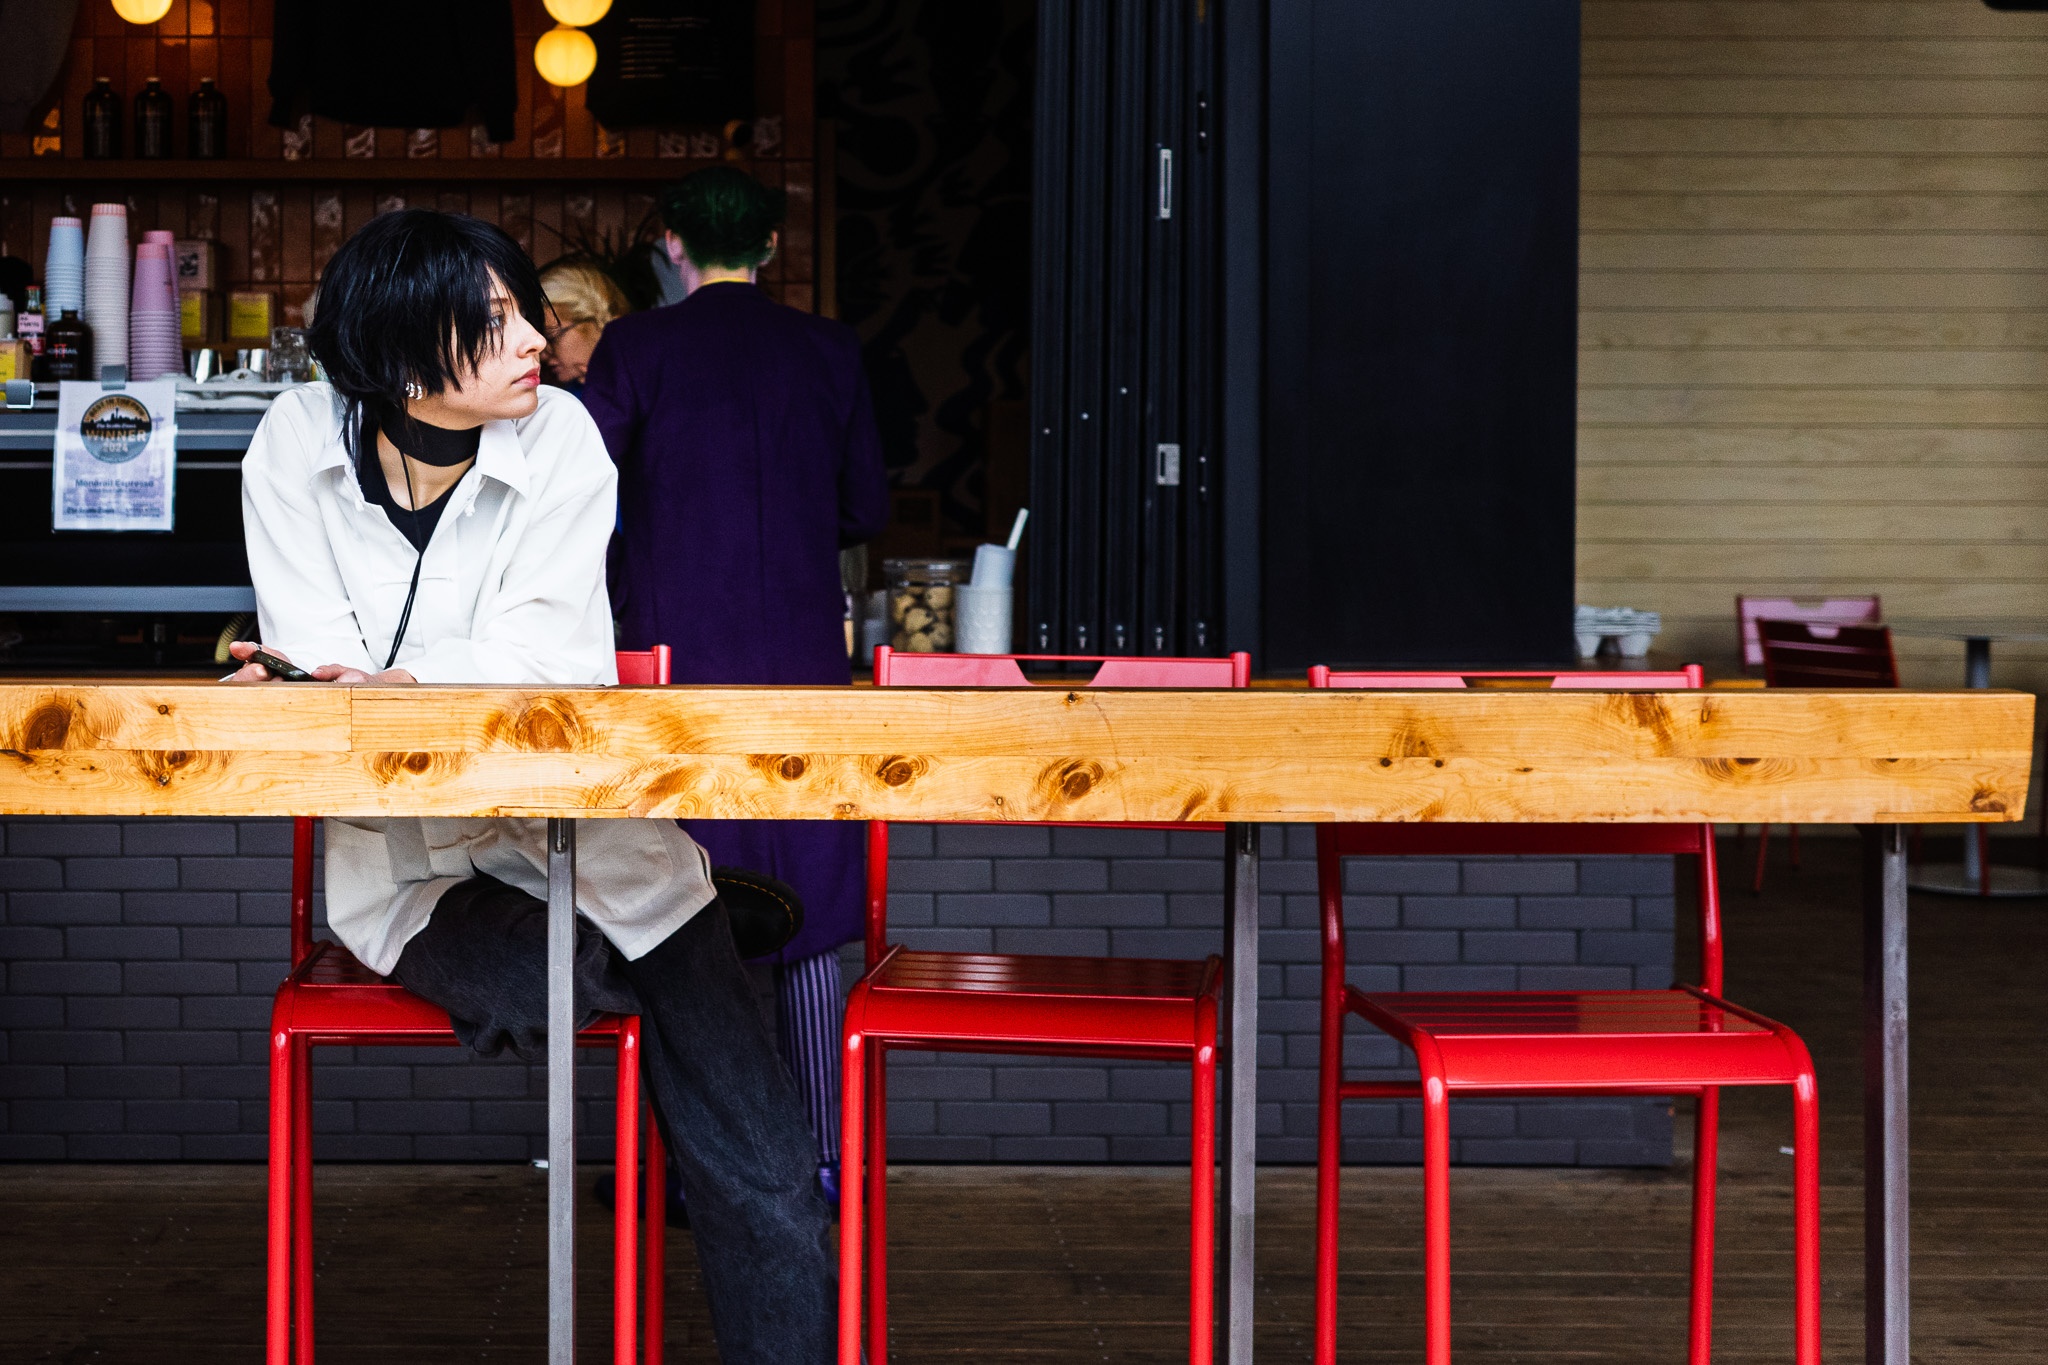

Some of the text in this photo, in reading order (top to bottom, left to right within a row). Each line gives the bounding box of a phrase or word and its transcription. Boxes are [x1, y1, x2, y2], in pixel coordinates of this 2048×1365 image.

[85, 429, 147, 442] WINNER
[102, 441, 129, 452] 2024
[76, 479, 154, 488] Monorail Espresso
